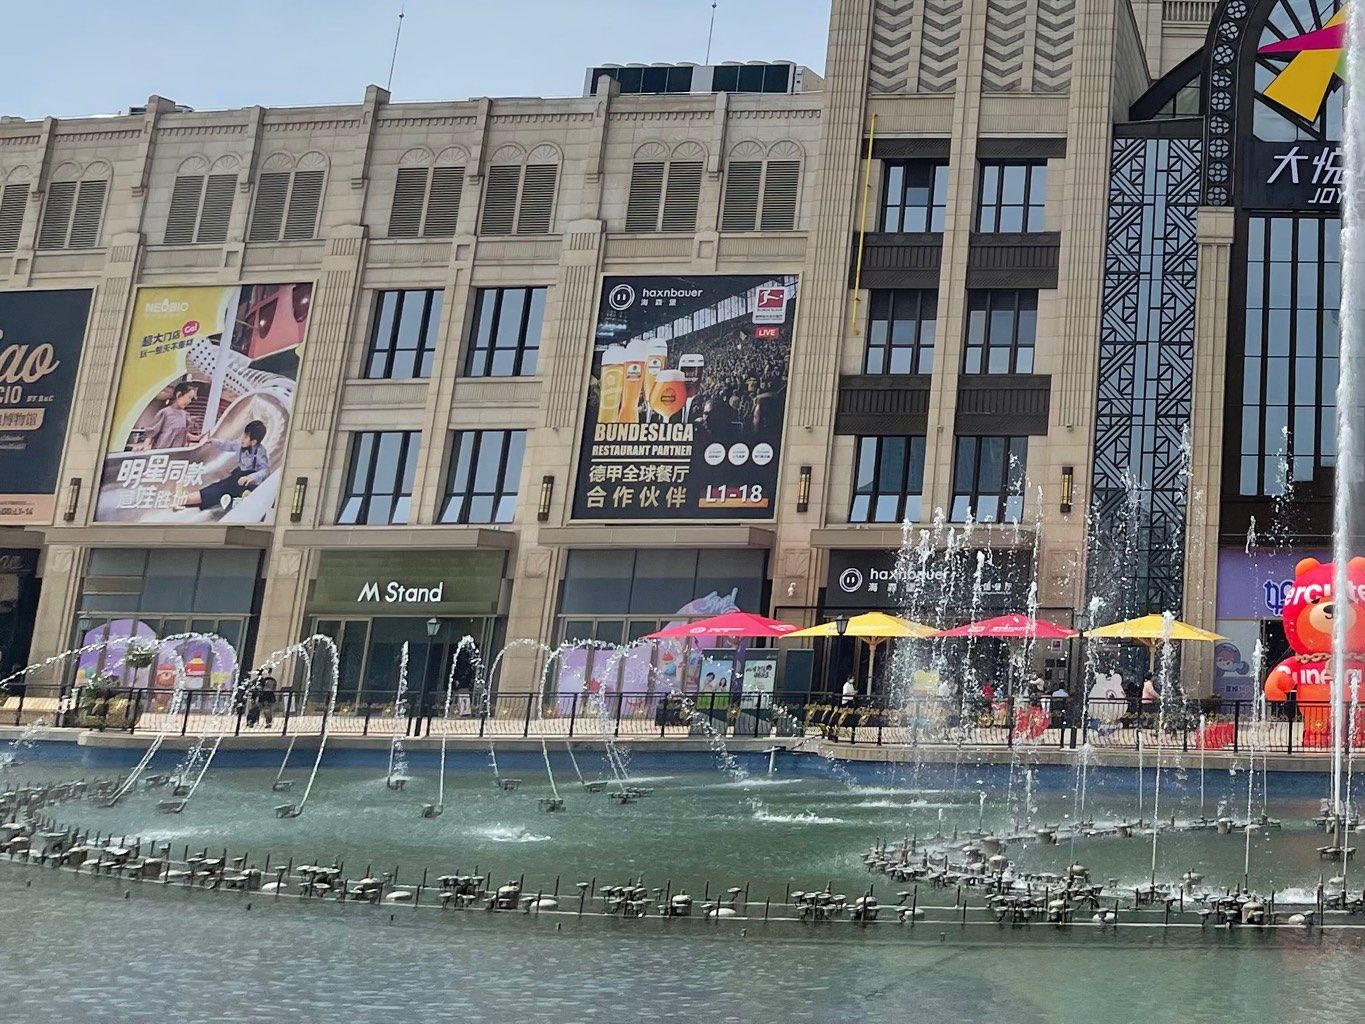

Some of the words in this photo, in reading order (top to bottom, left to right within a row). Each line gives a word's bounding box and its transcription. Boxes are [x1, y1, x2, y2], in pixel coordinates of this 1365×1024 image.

[642, 288, 703, 298] haxnbauer
[758, 329, 776, 337] LIVE
[593, 423, 694, 442] BUNDESLIGA
[592, 445, 651, 456] RESTAURANT
[651, 445, 693, 456] PARTNER
[116, 454, 207, 488] 明星同款
[589, 464, 690, 483] 德甲全球餐厅
[586, 485, 687, 508] 合作伙伴
[705, 484, 763, 503] L1-18
[357, 581, 380, 602] M
[385, 581, 444, 602] Stand
